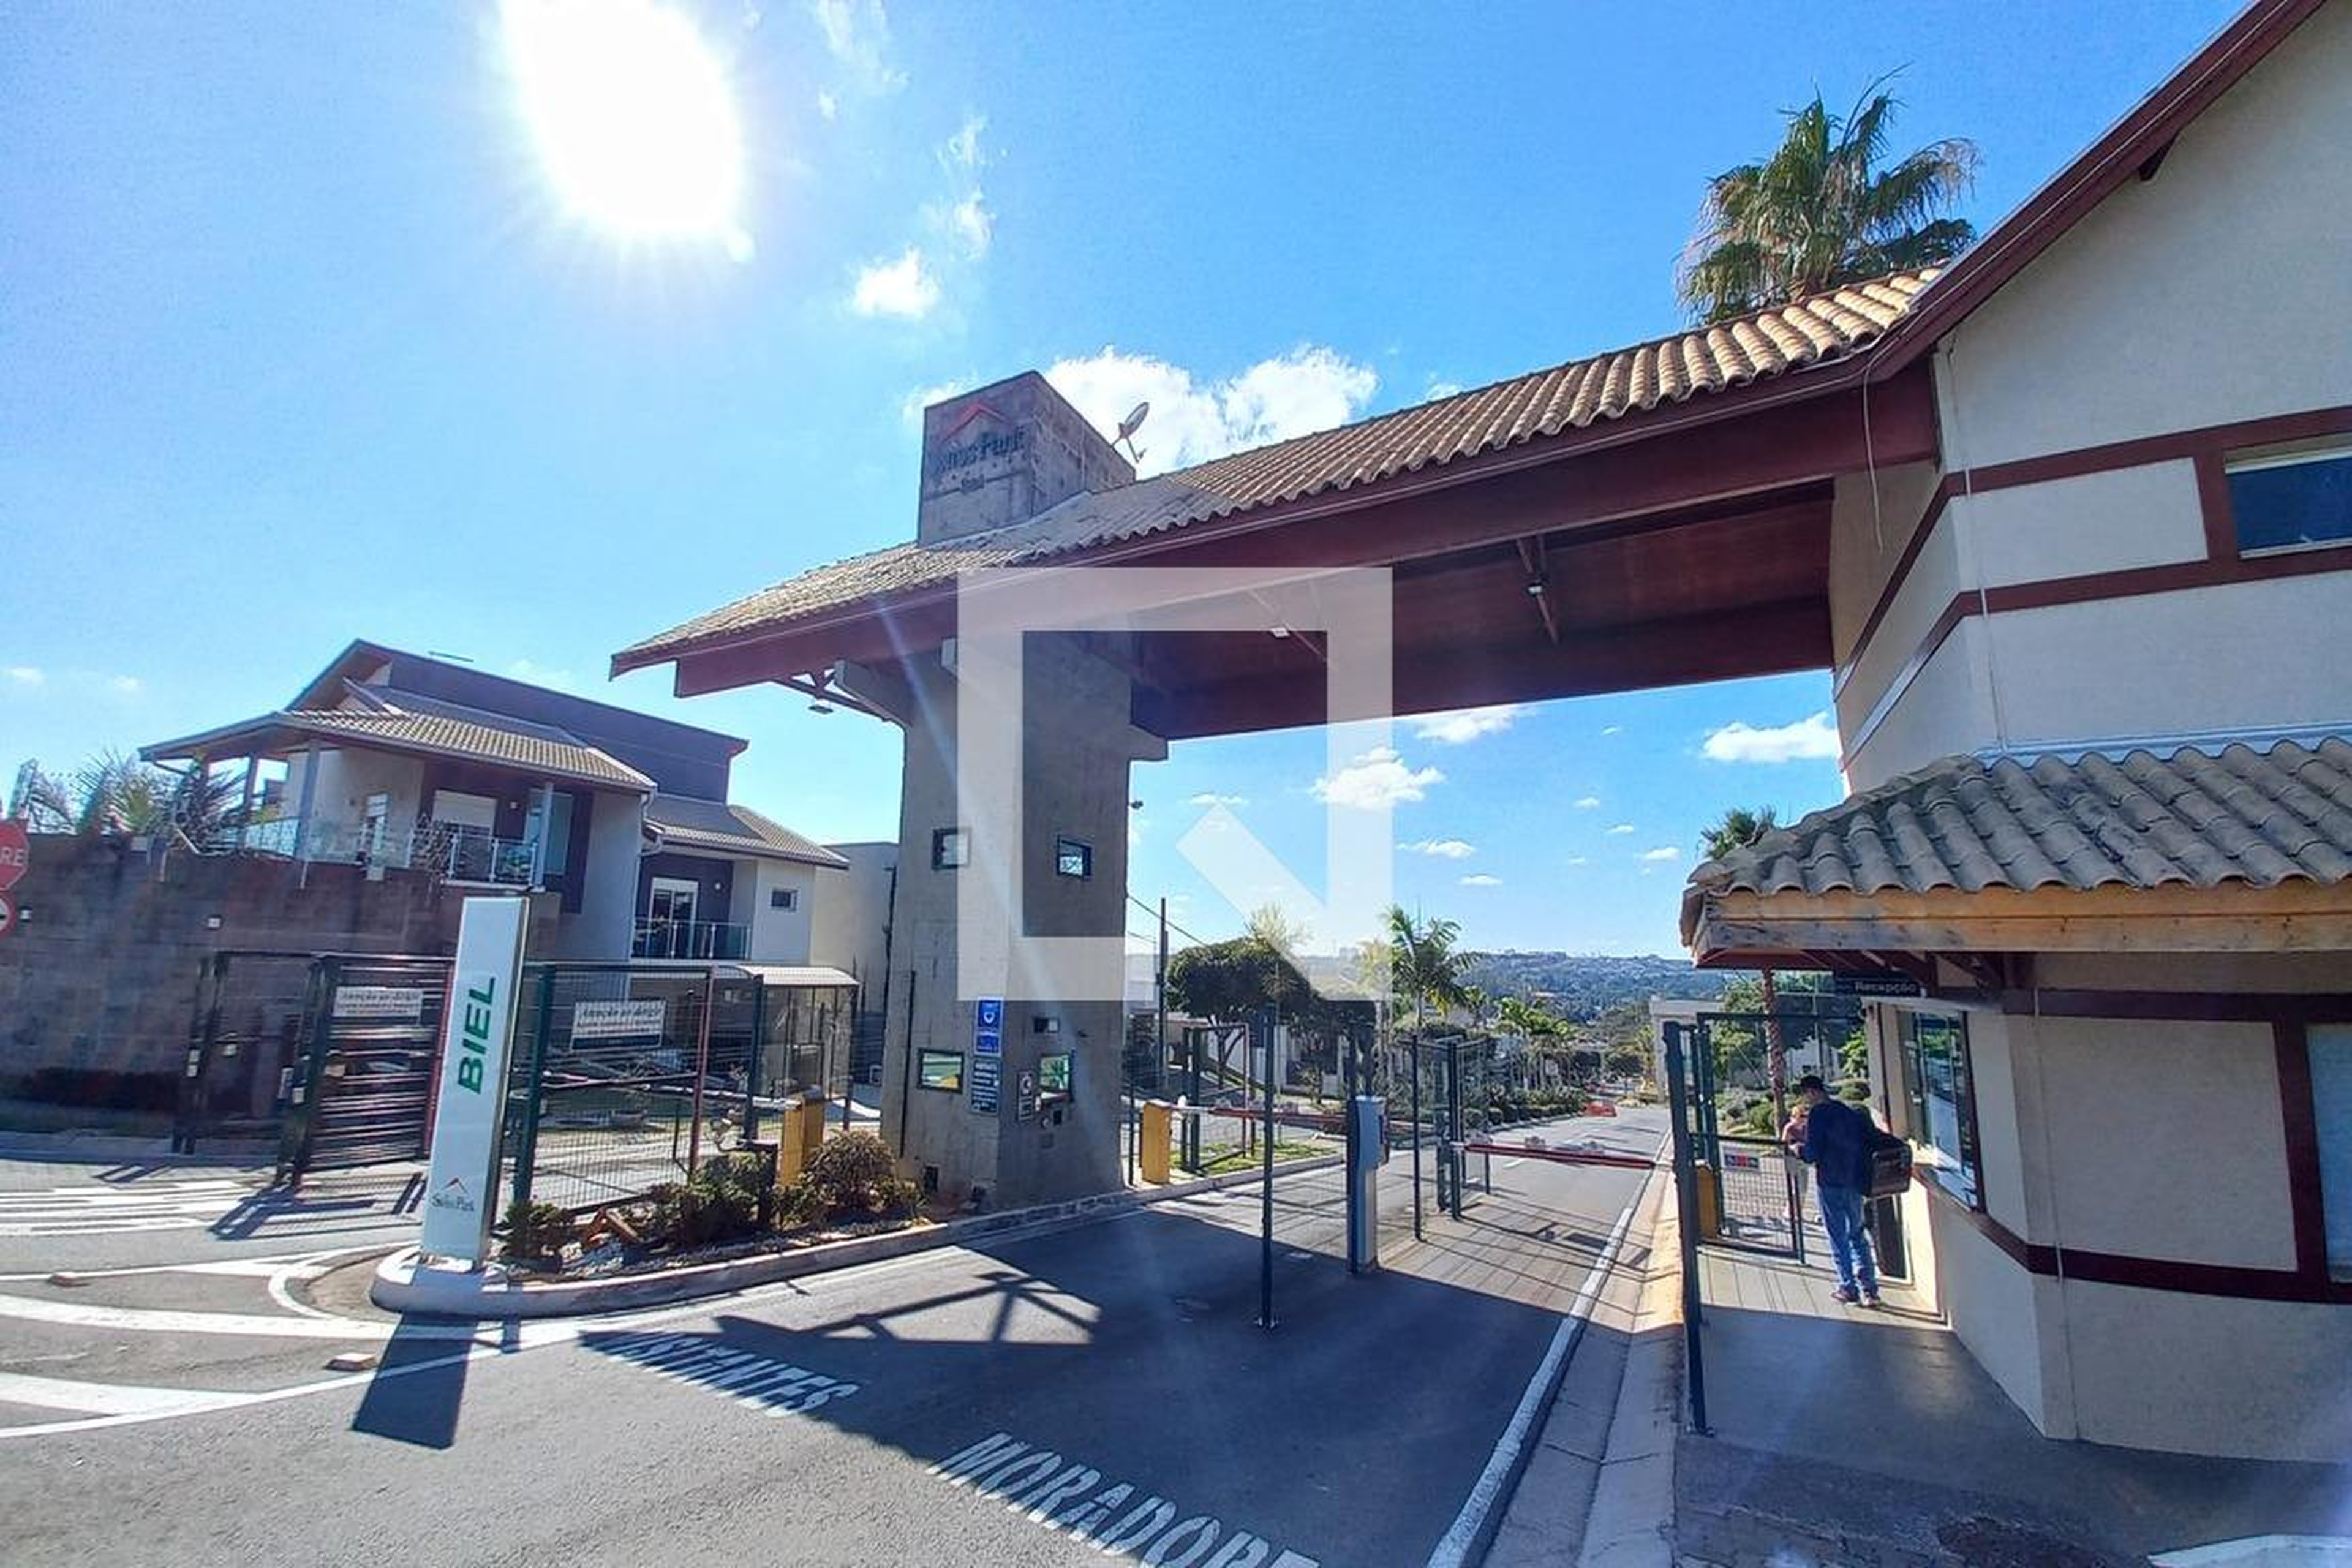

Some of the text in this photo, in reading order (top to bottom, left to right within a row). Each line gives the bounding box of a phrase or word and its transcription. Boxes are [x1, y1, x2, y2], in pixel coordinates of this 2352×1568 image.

[1, 846, 24, 867] RE
[1855, 981, 1917, 994] Recepção
[458, 977, 496, 1095] BIEL
[924, 1432, 1321, 1568] MORADOR
